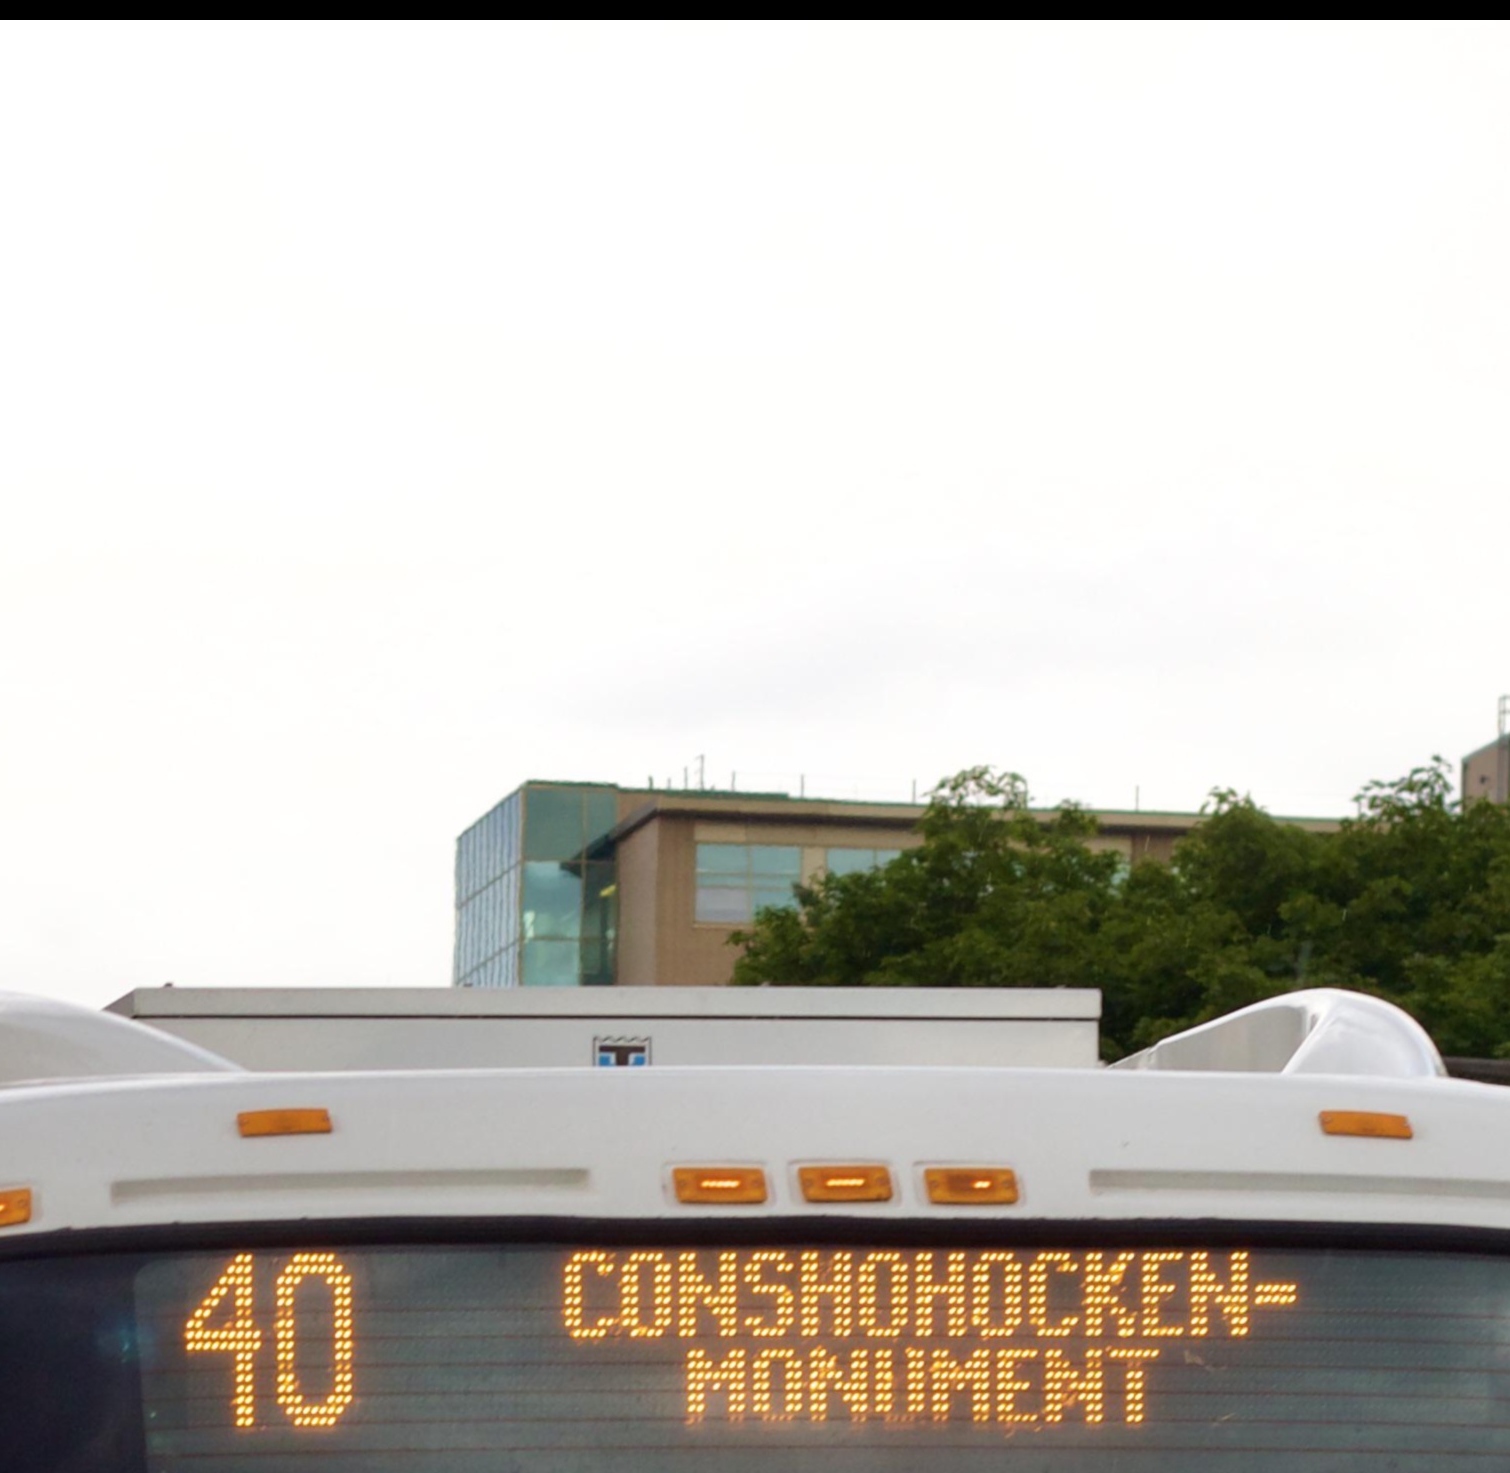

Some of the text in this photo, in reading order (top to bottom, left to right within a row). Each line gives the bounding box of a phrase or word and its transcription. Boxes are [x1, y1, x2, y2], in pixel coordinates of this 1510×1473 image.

[563, 1251, 1298, 1338] CONSHOHOCKEN-
[183, 1253, 352, 1427] 40
[686, 1348, 1160, 1425] MONUMENT
